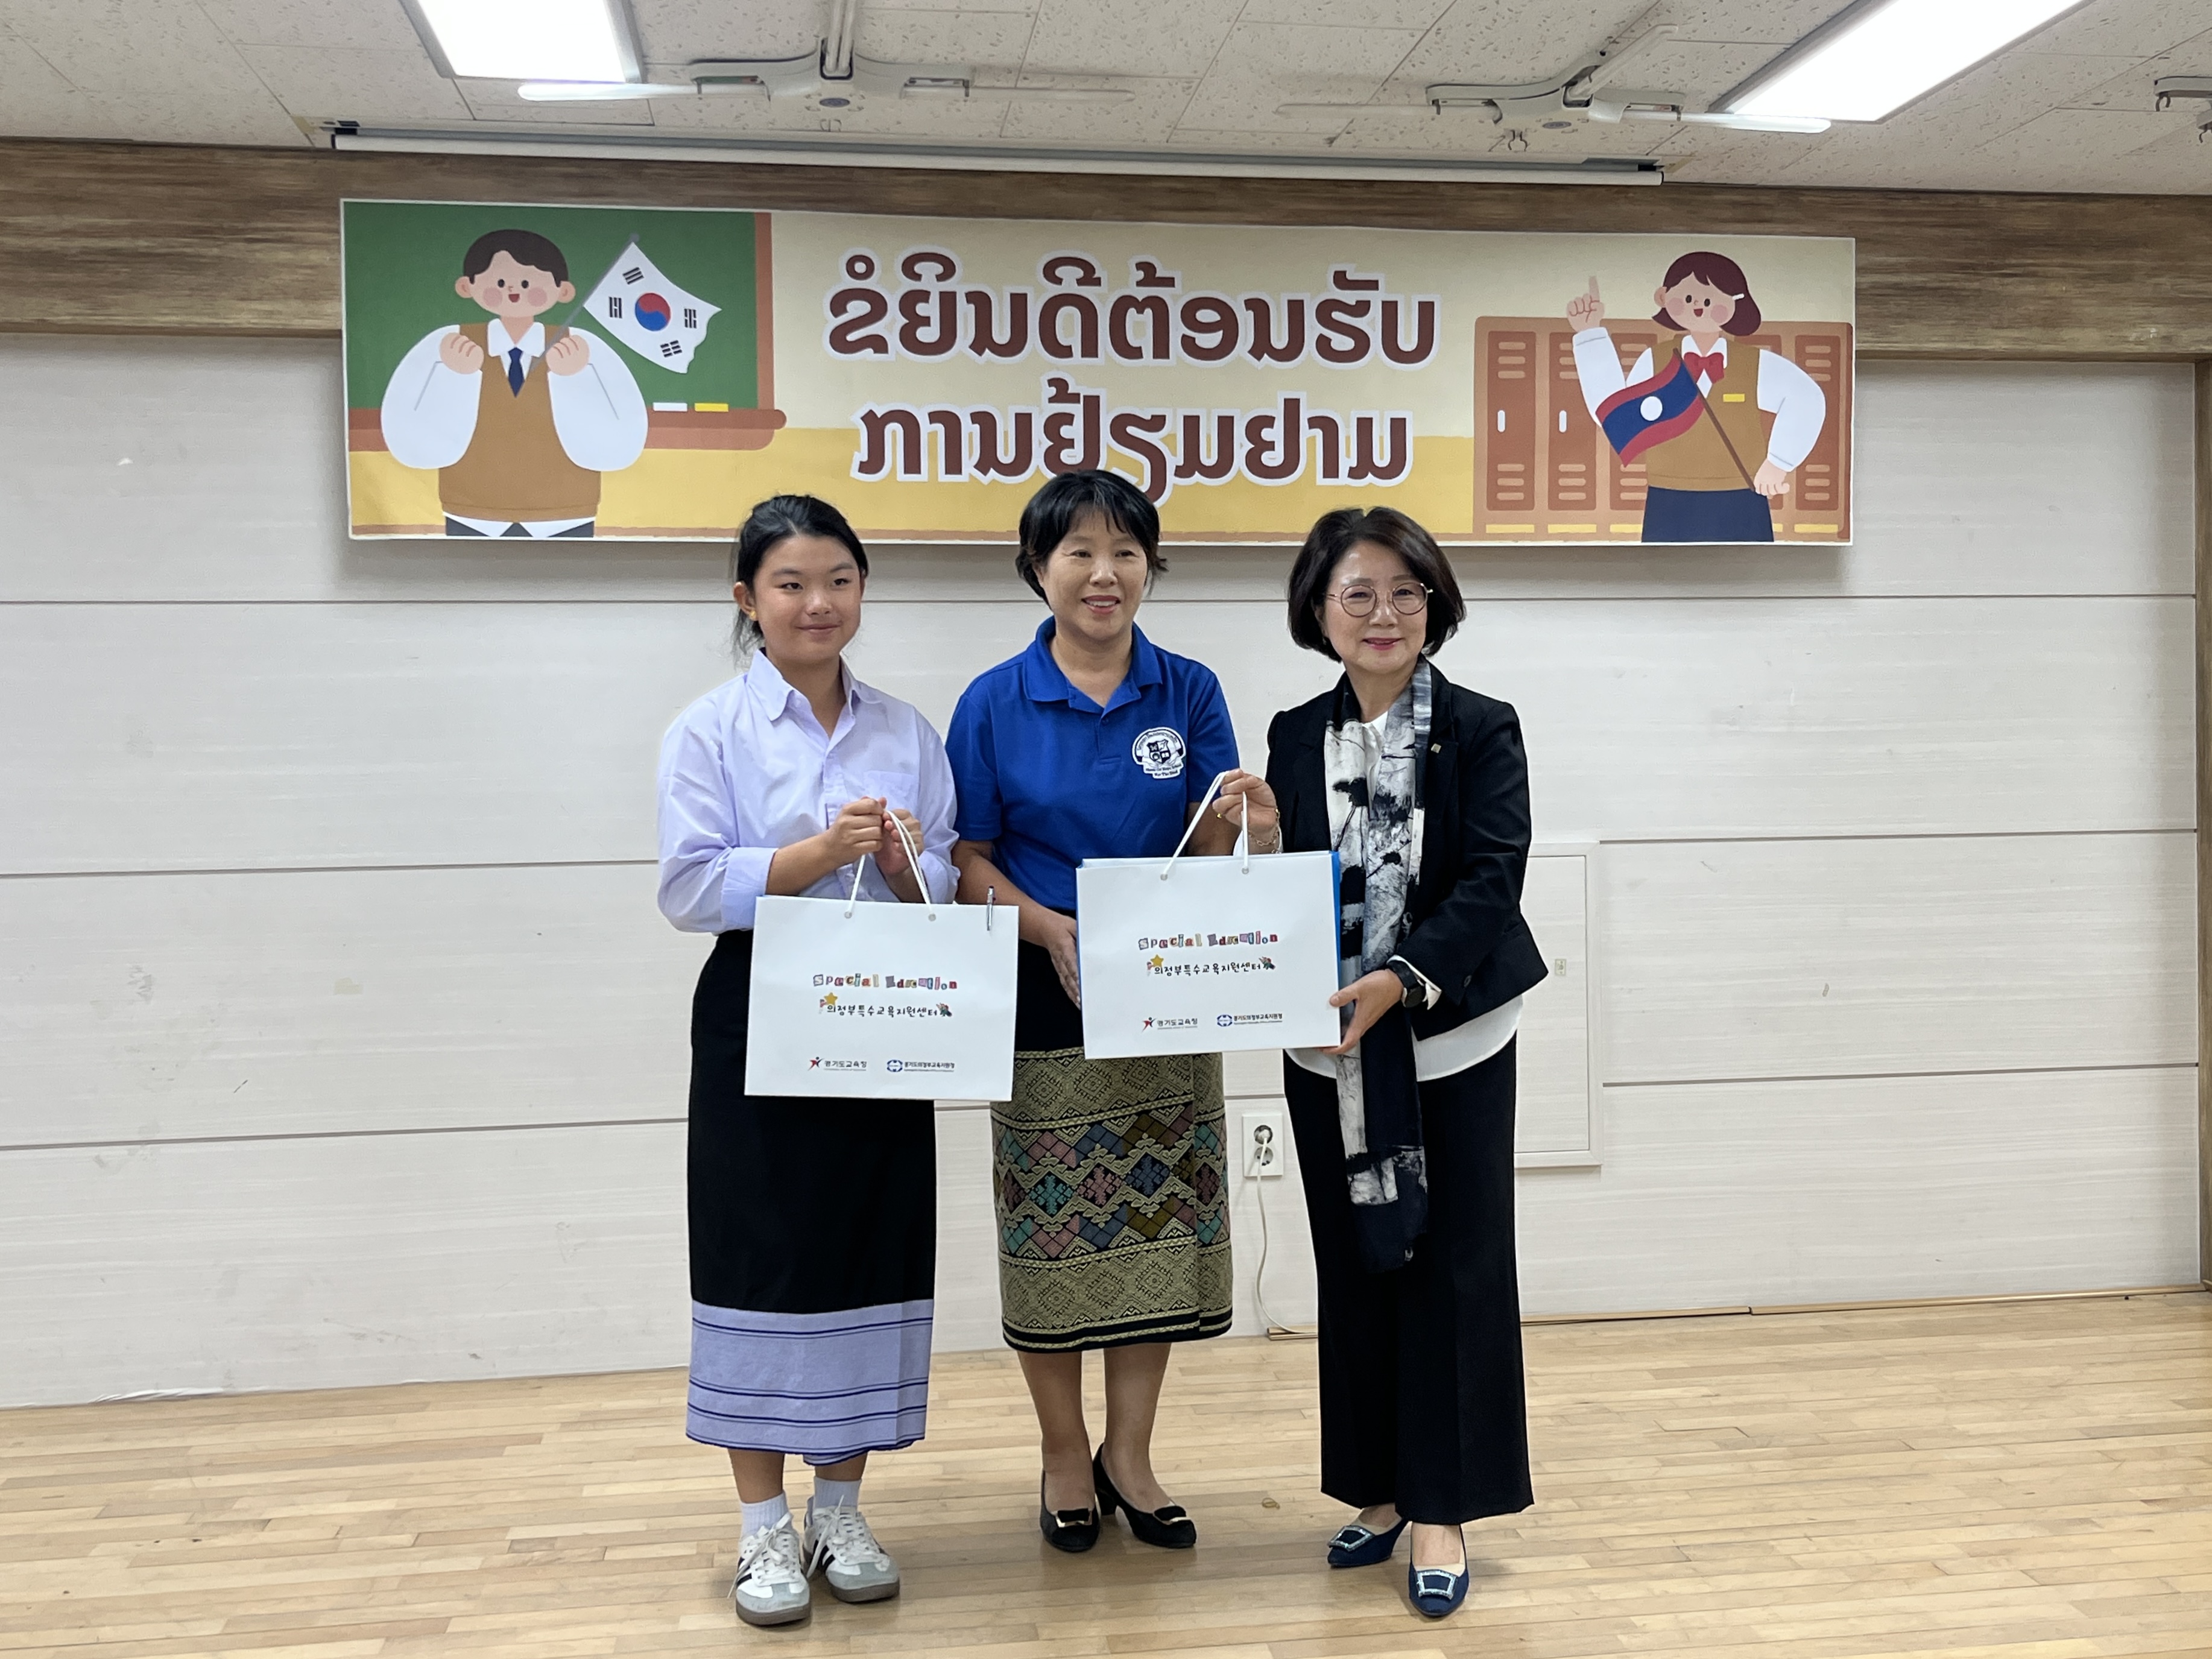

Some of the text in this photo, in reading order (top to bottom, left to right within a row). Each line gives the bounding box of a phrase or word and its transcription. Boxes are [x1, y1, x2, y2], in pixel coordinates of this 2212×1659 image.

[829, 251, 1435, 364] ຂໍຍິນດີຕ້ອນຮັບ
[1138, 934, 1202, 950] Special
[1154, 962, 1261, 976] 의정부특수교육지원센터
[813, 973, 879, 987] Special
[827, 1005, 937, 1017] 의정부특수교육지원센터
